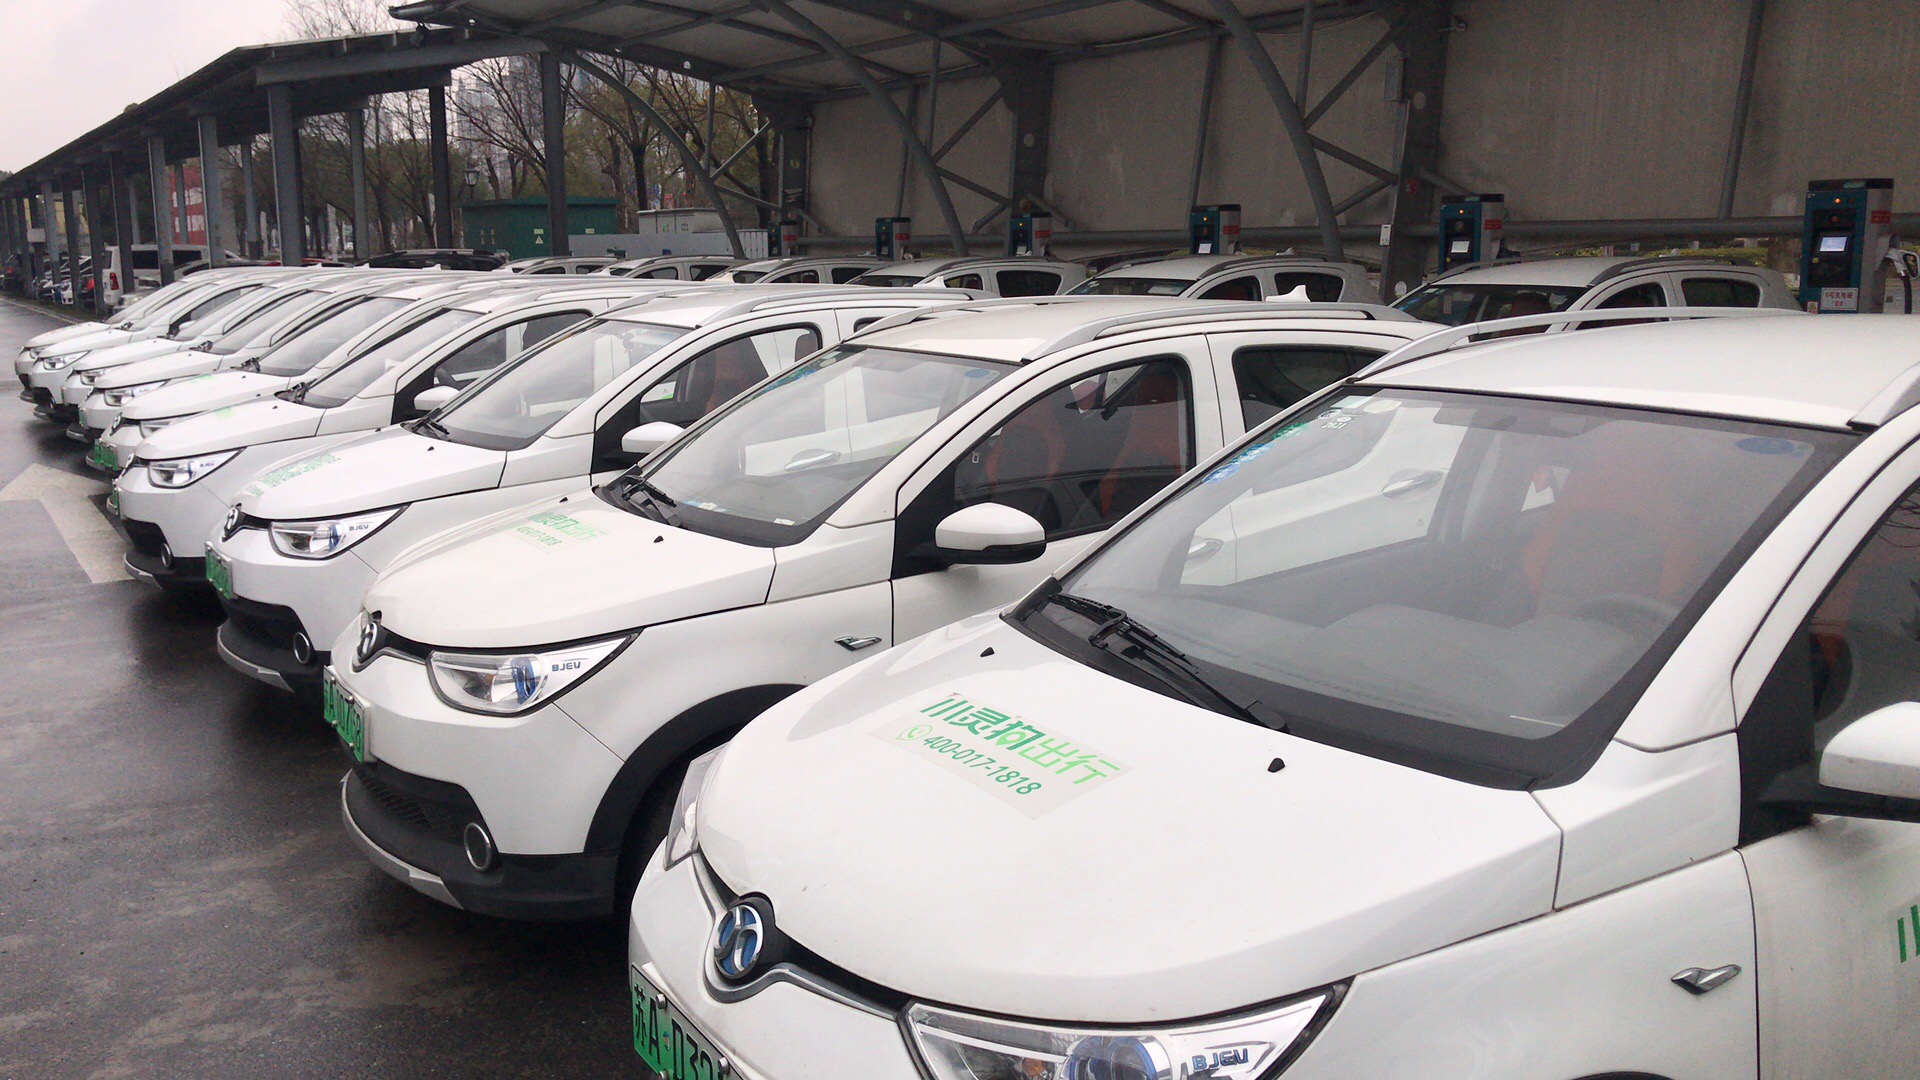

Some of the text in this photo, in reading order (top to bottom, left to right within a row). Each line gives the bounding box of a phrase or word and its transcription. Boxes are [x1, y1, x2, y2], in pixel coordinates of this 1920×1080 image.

[552, 661, 581, 671] BJEV
[919, 698, 1120, 785] 小灵狗出行
[923, 736, 1042, 795] 400-017-1818
[1192, 1048, 1249, 1071] BJEV
